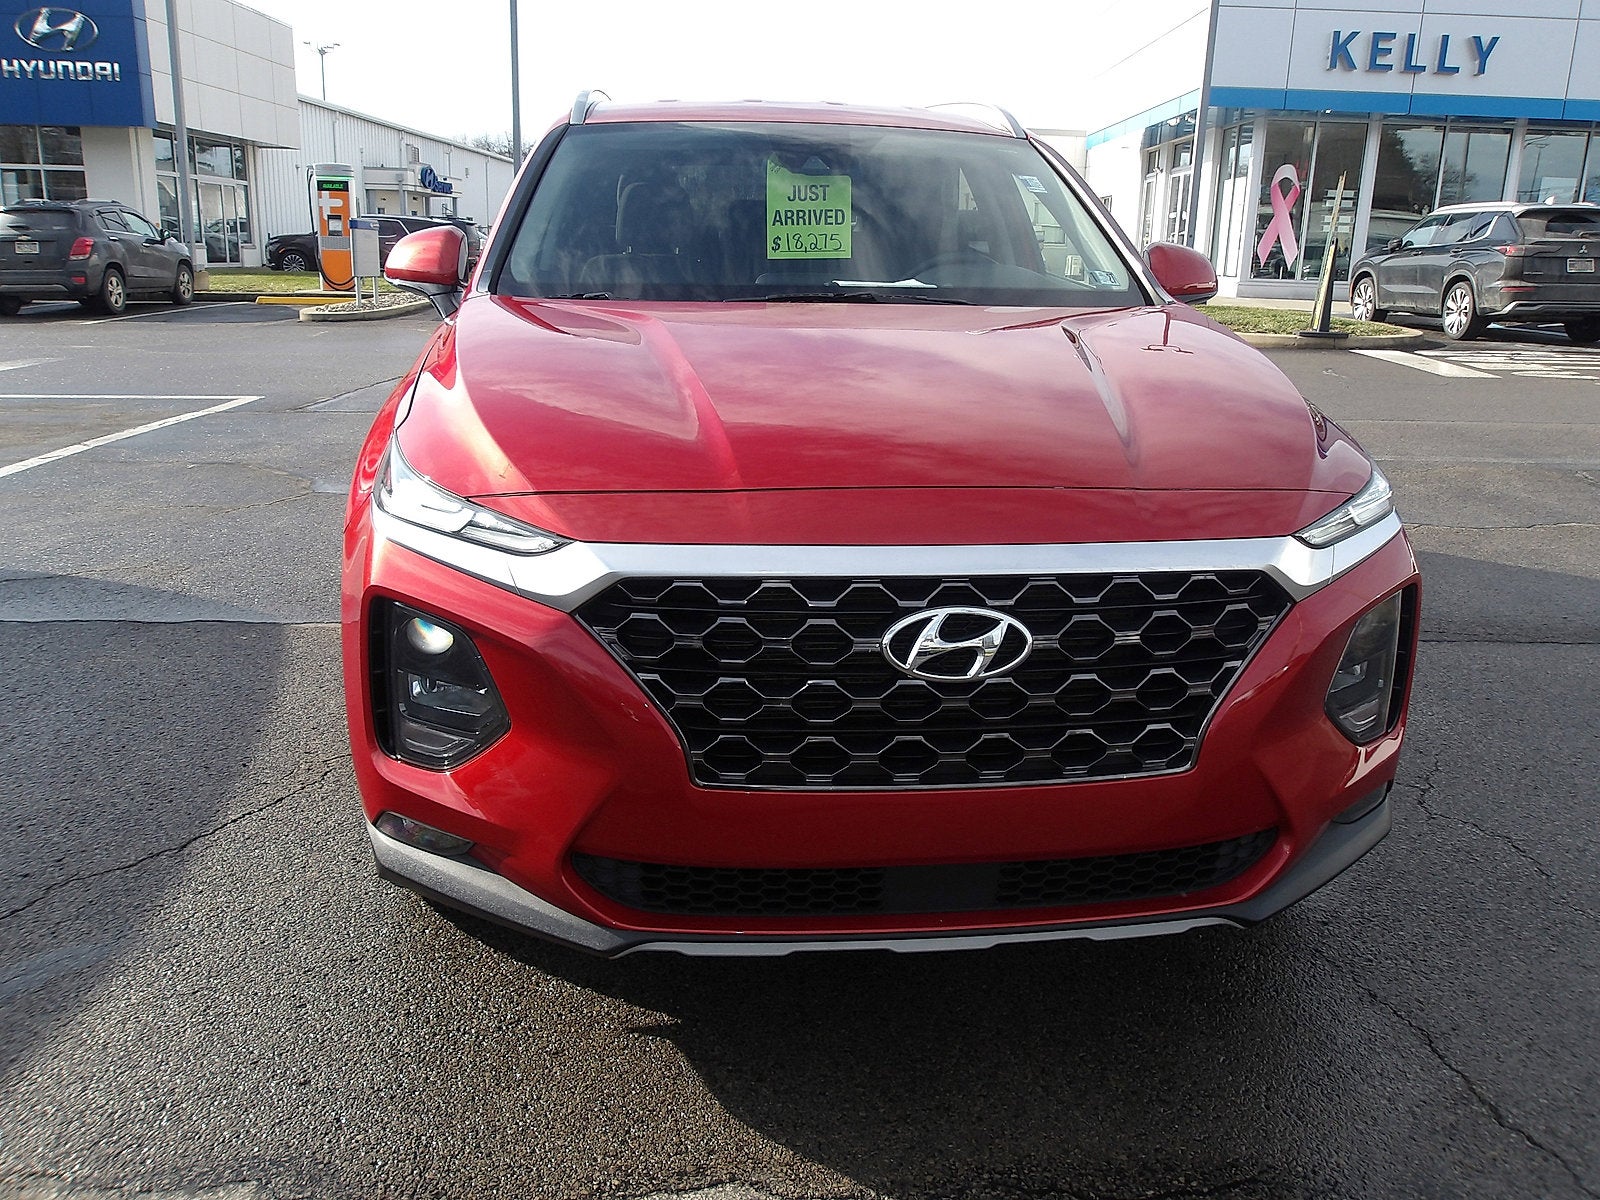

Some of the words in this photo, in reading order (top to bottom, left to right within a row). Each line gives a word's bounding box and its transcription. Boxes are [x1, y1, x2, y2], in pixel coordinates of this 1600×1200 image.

[1327, 30, 1501, 76] KELLY
[0, 58, 121, 82] HYUNDAI
[787, 184, 830, 202] JUST
[771, 208, 846, 227] ARRIVED
[771, 232, 843, 254] $18,275
